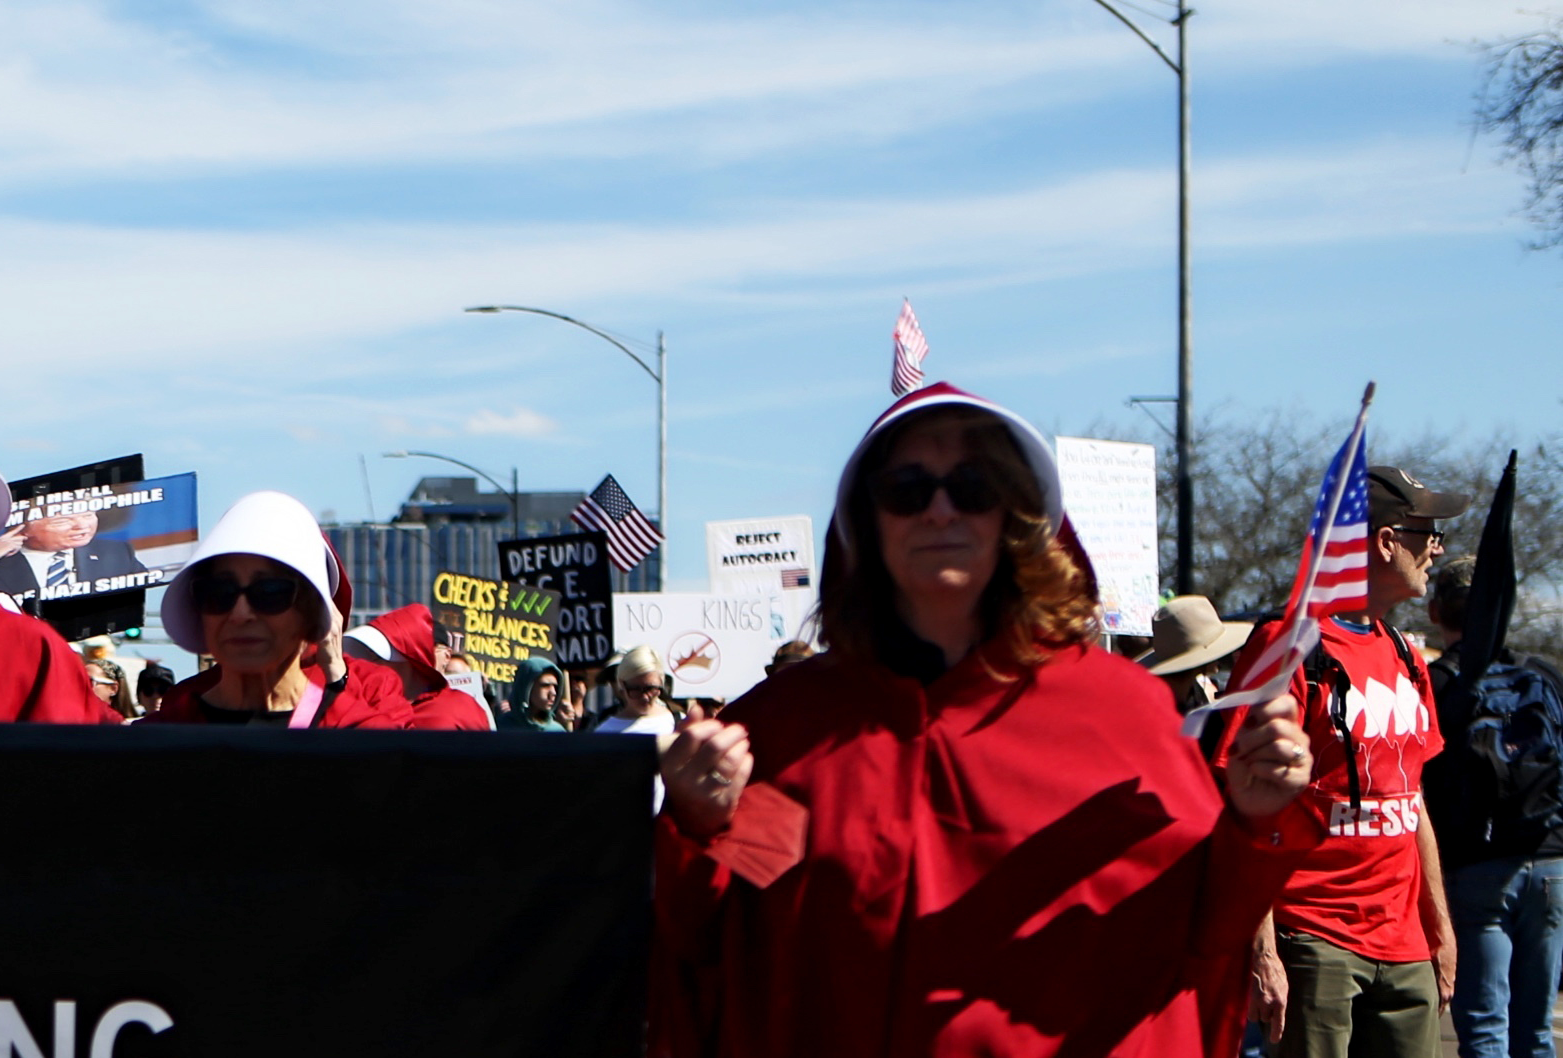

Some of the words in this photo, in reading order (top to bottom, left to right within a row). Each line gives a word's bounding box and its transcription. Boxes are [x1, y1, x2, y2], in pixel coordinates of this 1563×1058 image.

[28, 507, 44, 521] A
[47, 487, 164, 518] PEDOPHILE
[735, 532, 781, 546] REJECT
[507, 541, 597, 576] DEFUND
[722, 551, 798, 567] AUTOCRACY
[40, 582, 91, 601] NAZI
[94, 569, 164, 592] SHIT?
[433, 572, 497, 611] CHECKS
[463, 608, 552, 652] BALANCES,
[626, 603, 663, 632] NO
[702, 599, 764, 632] KINGS
[465, 633, 511, 659] KINGS
